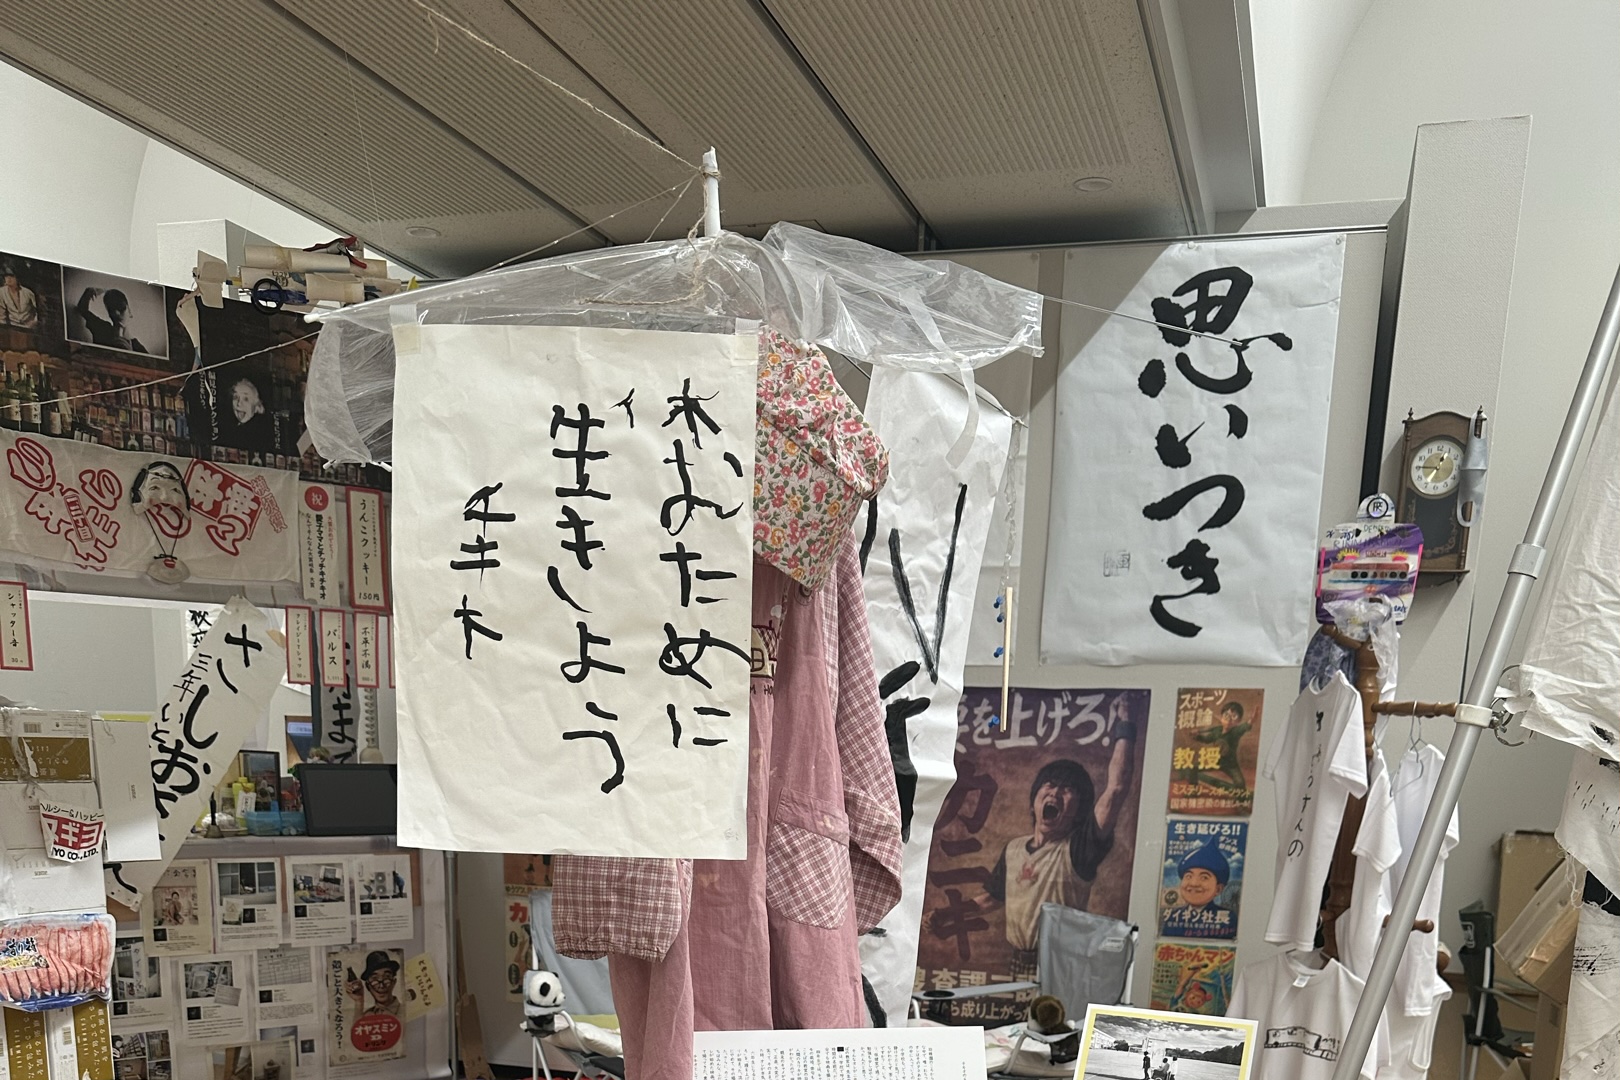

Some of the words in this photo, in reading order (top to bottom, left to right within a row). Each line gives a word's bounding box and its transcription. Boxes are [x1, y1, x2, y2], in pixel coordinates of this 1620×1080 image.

[1138, 266, 1293, 639] 思いつき
[359, 498, 371, 586] うんこクッキー
[327, 629, 338, 665] バルス
[1179, 689, 1227, 710] スポーツ
[1173, 747, 1221, 770] 教授
[1174, 822, 1241, 836] 生き延びろ!!
[929, 760, 999, 960] カニキ
[1157, 945, 1235, 965] 赤ちゃんマン
[354, 1022, 398, 1036] オヤスミン
